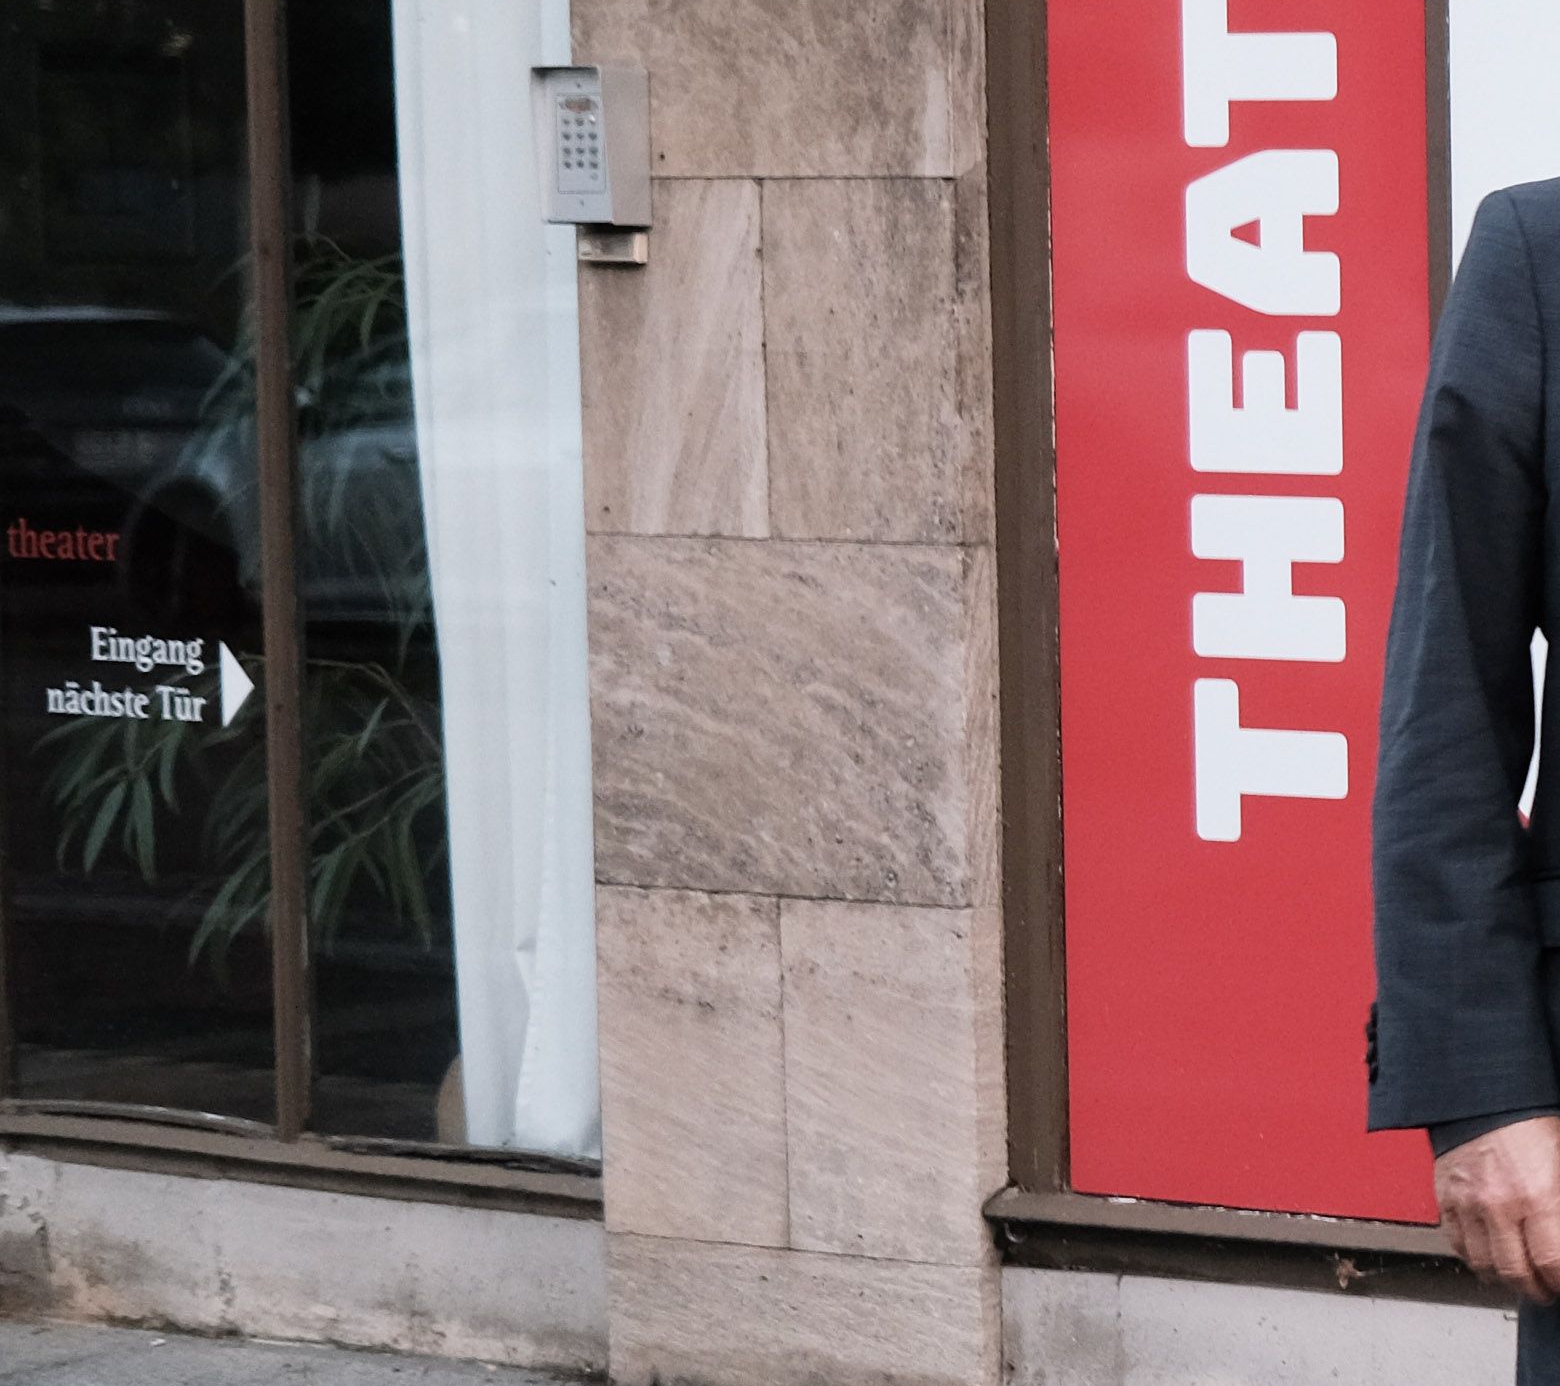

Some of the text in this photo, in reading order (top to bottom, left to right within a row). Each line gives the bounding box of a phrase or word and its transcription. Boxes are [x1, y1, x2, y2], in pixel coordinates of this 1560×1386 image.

[7, 517, 120, 561] theater
[89, 625, 205, 675] Eingang
[47, 680, 207, 722] nächste Tür
